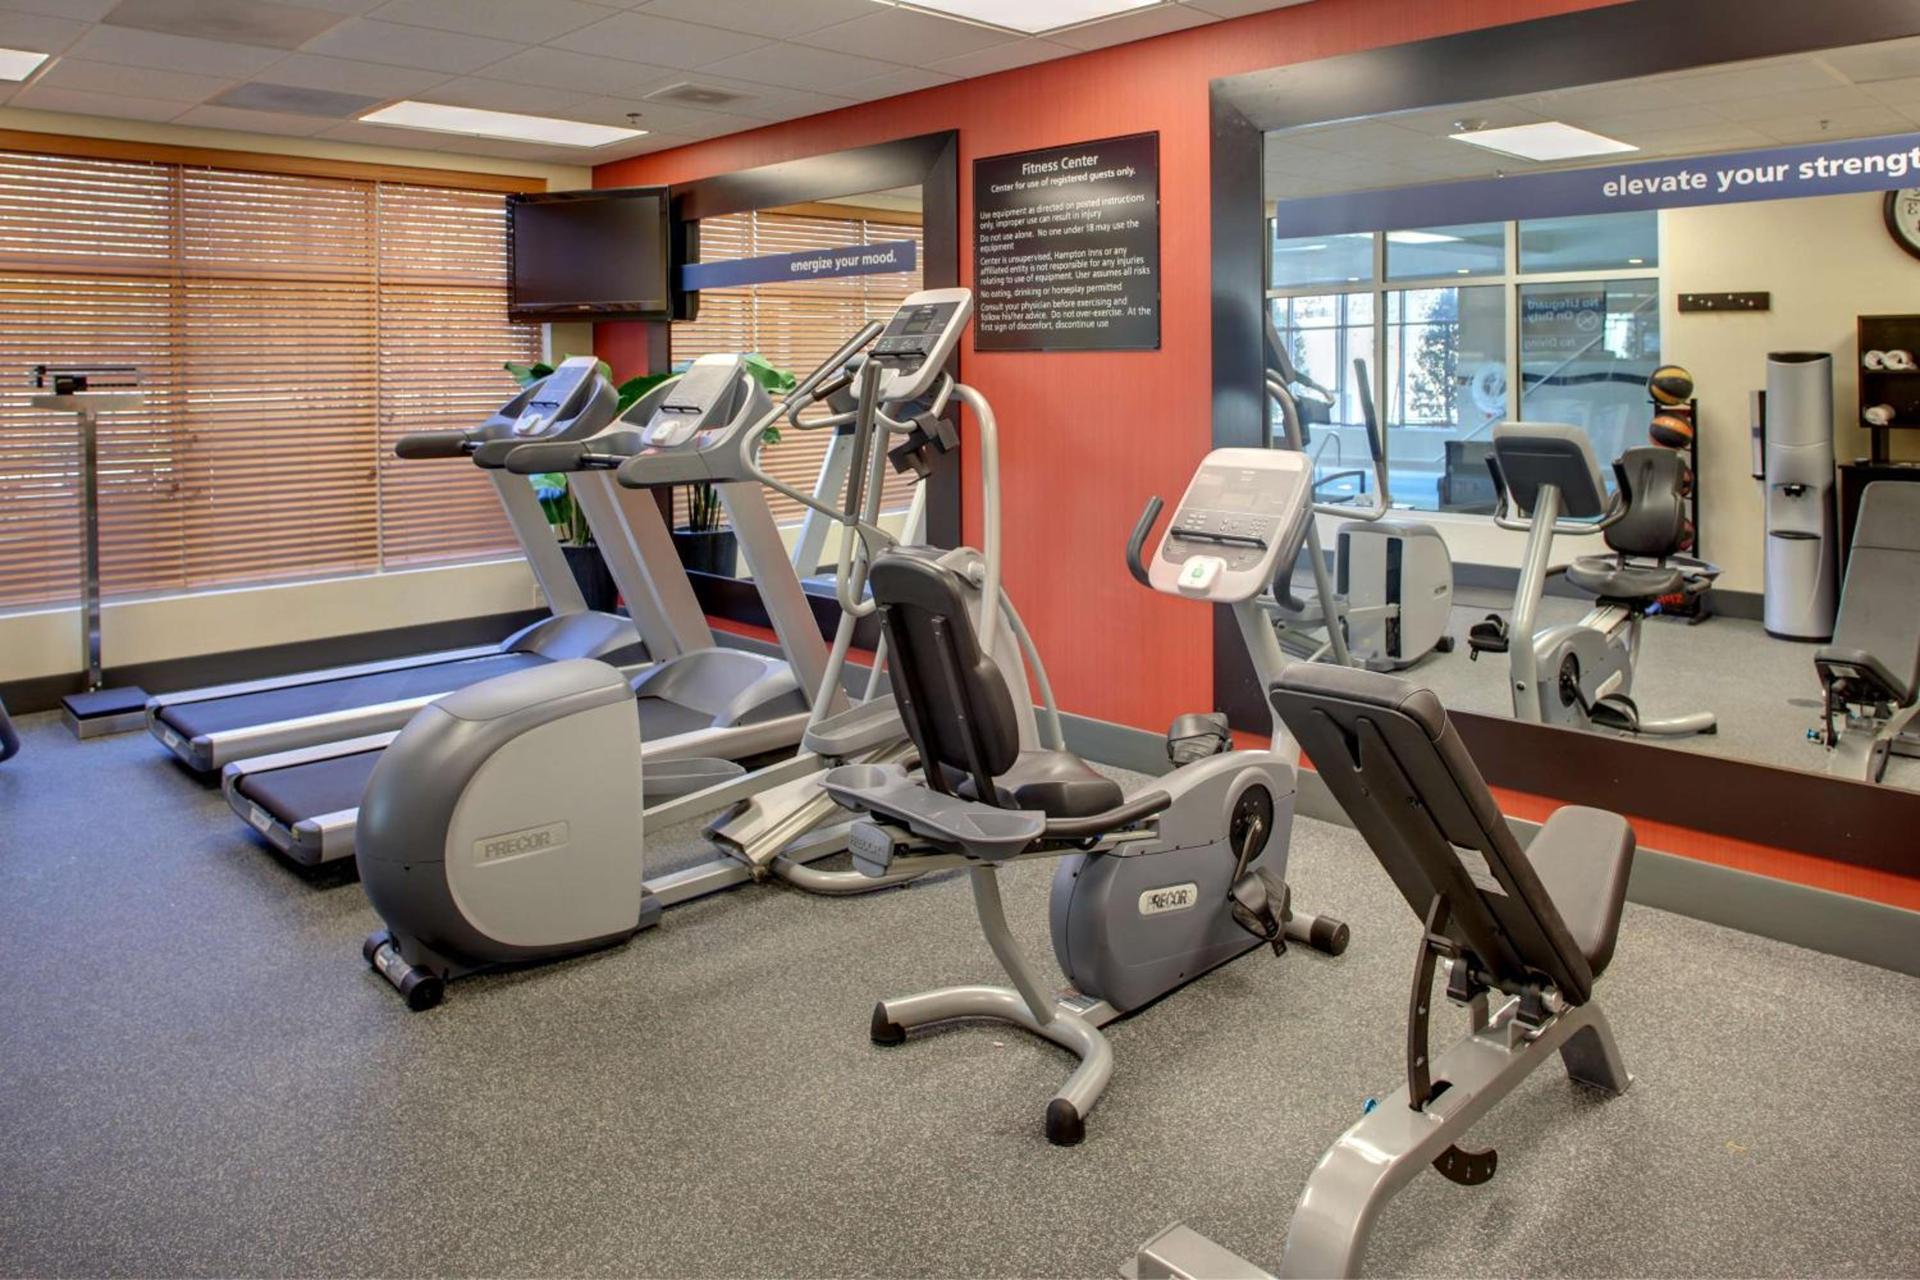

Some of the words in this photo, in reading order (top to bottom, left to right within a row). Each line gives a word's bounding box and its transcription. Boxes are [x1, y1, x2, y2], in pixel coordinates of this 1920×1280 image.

[1022, 161, 1058, 175] Fitness
[1061, 155, 1099, 169] Center
[991, 184, 1014, 193] Center
[1015, 181, 1026, 190] for
[1027, 181, 1040, 189] use
[1041, 177, 1049, 186] of
[1050, 172, 1088, 187] registered
[1089, 169, 1115, 182] guests
[1116, 165, 1136, 177] only.
[1603, 169, 1708, 197] elevate
[1717, 162, 1791, 192] your
[980, 211, 991, 219] Use
[992, 207, 1027, 219] equipment
[1036, 203, 1064, 213] directed
[1065, 202, 1075, 210] on
[1075, 198, 1100, 210] posted
[1101, 194, 1145, 205] instructions
[995, 217, 1025, 228] improper
[1039, 215, 1050, 223] can
[1051, 212, 1071, 221] result
[1072, 211, 1080, 219] in
[1080, 208, 1102, 220] injury
[980, 233, 989, 242] Do
[990, 232, 1001, 241] not
[1037, 228, 1047, 236] No
[1048, 227, 1061, 235] one
[1063, 225, 1084, 235] under
[1086, 223, 1094, 232] 18
[1095, 223, 1111, 232] may
[1112, 222, 1125, 230] use
[1126, 218, 1139, 228] the
[980, 243, 1015, 253] equipment
[980, 256, 1001, 265] Center
[1001, 256, 1007, 264] is
[1054, 250, 1086, 260] Hampton
[1088, 248, 1103, 257] Inns
[1104, 248, 1113, 256] or
[1113, 247, 1127, 258] any
[790, 256, 833, 273] energize
[835, 255, 860, 271] your
[862, 249, 897, 265] mood.
[1010, 264, 1028, 274] entity
[1036, 263, 1048, 271] not
[1049, 260, 1088, 271] responsible
[1089, 259, 1100, 268] for
[1101, 259, 1115, 268] any
[1117, 256, 1144, 266] injuries
[1014, 275, 1025, 283] use
[1026, 274, 1034, 282] of
[1075, 270, 1090, 279] User
[1092, 269, 1122, 278] assumes
[1123, 267, 1132, 276] all
[1133, 267, 1151, 275] risks
[980, 290, 989, 298] No
[1014, 288, 1041, 297] drinking
[1043, 287, 1051, 295] or
[1051, 285, 1085, 296] horseplay
[1086, 282, 1122, 293] permitted
[980, 303, 1003, 311] Consult
[1004, 303, 1020, 311] your
[1021, 300, 1052, 311] physician
[1052, 299, 1075, 308] before
[1077, 297, 1112, 308] exercising
[1113, 296, 1128, 306] and
[981, 312, 1001, 321] follow
[1051, 310, 1061, 319] Do
[1063, 310, 1075, 318] not
[1127, 307, 1137, 316] At
[1138, 306, 1152, 316] the
[994, 322, 1008, 333] sign
[1008, 322, 1016, 330] of
[1055, 320, 1096, 330] discontinue
[1096, 320, 1110, 328] use
[484, 831, 551, 858] PRECOR
